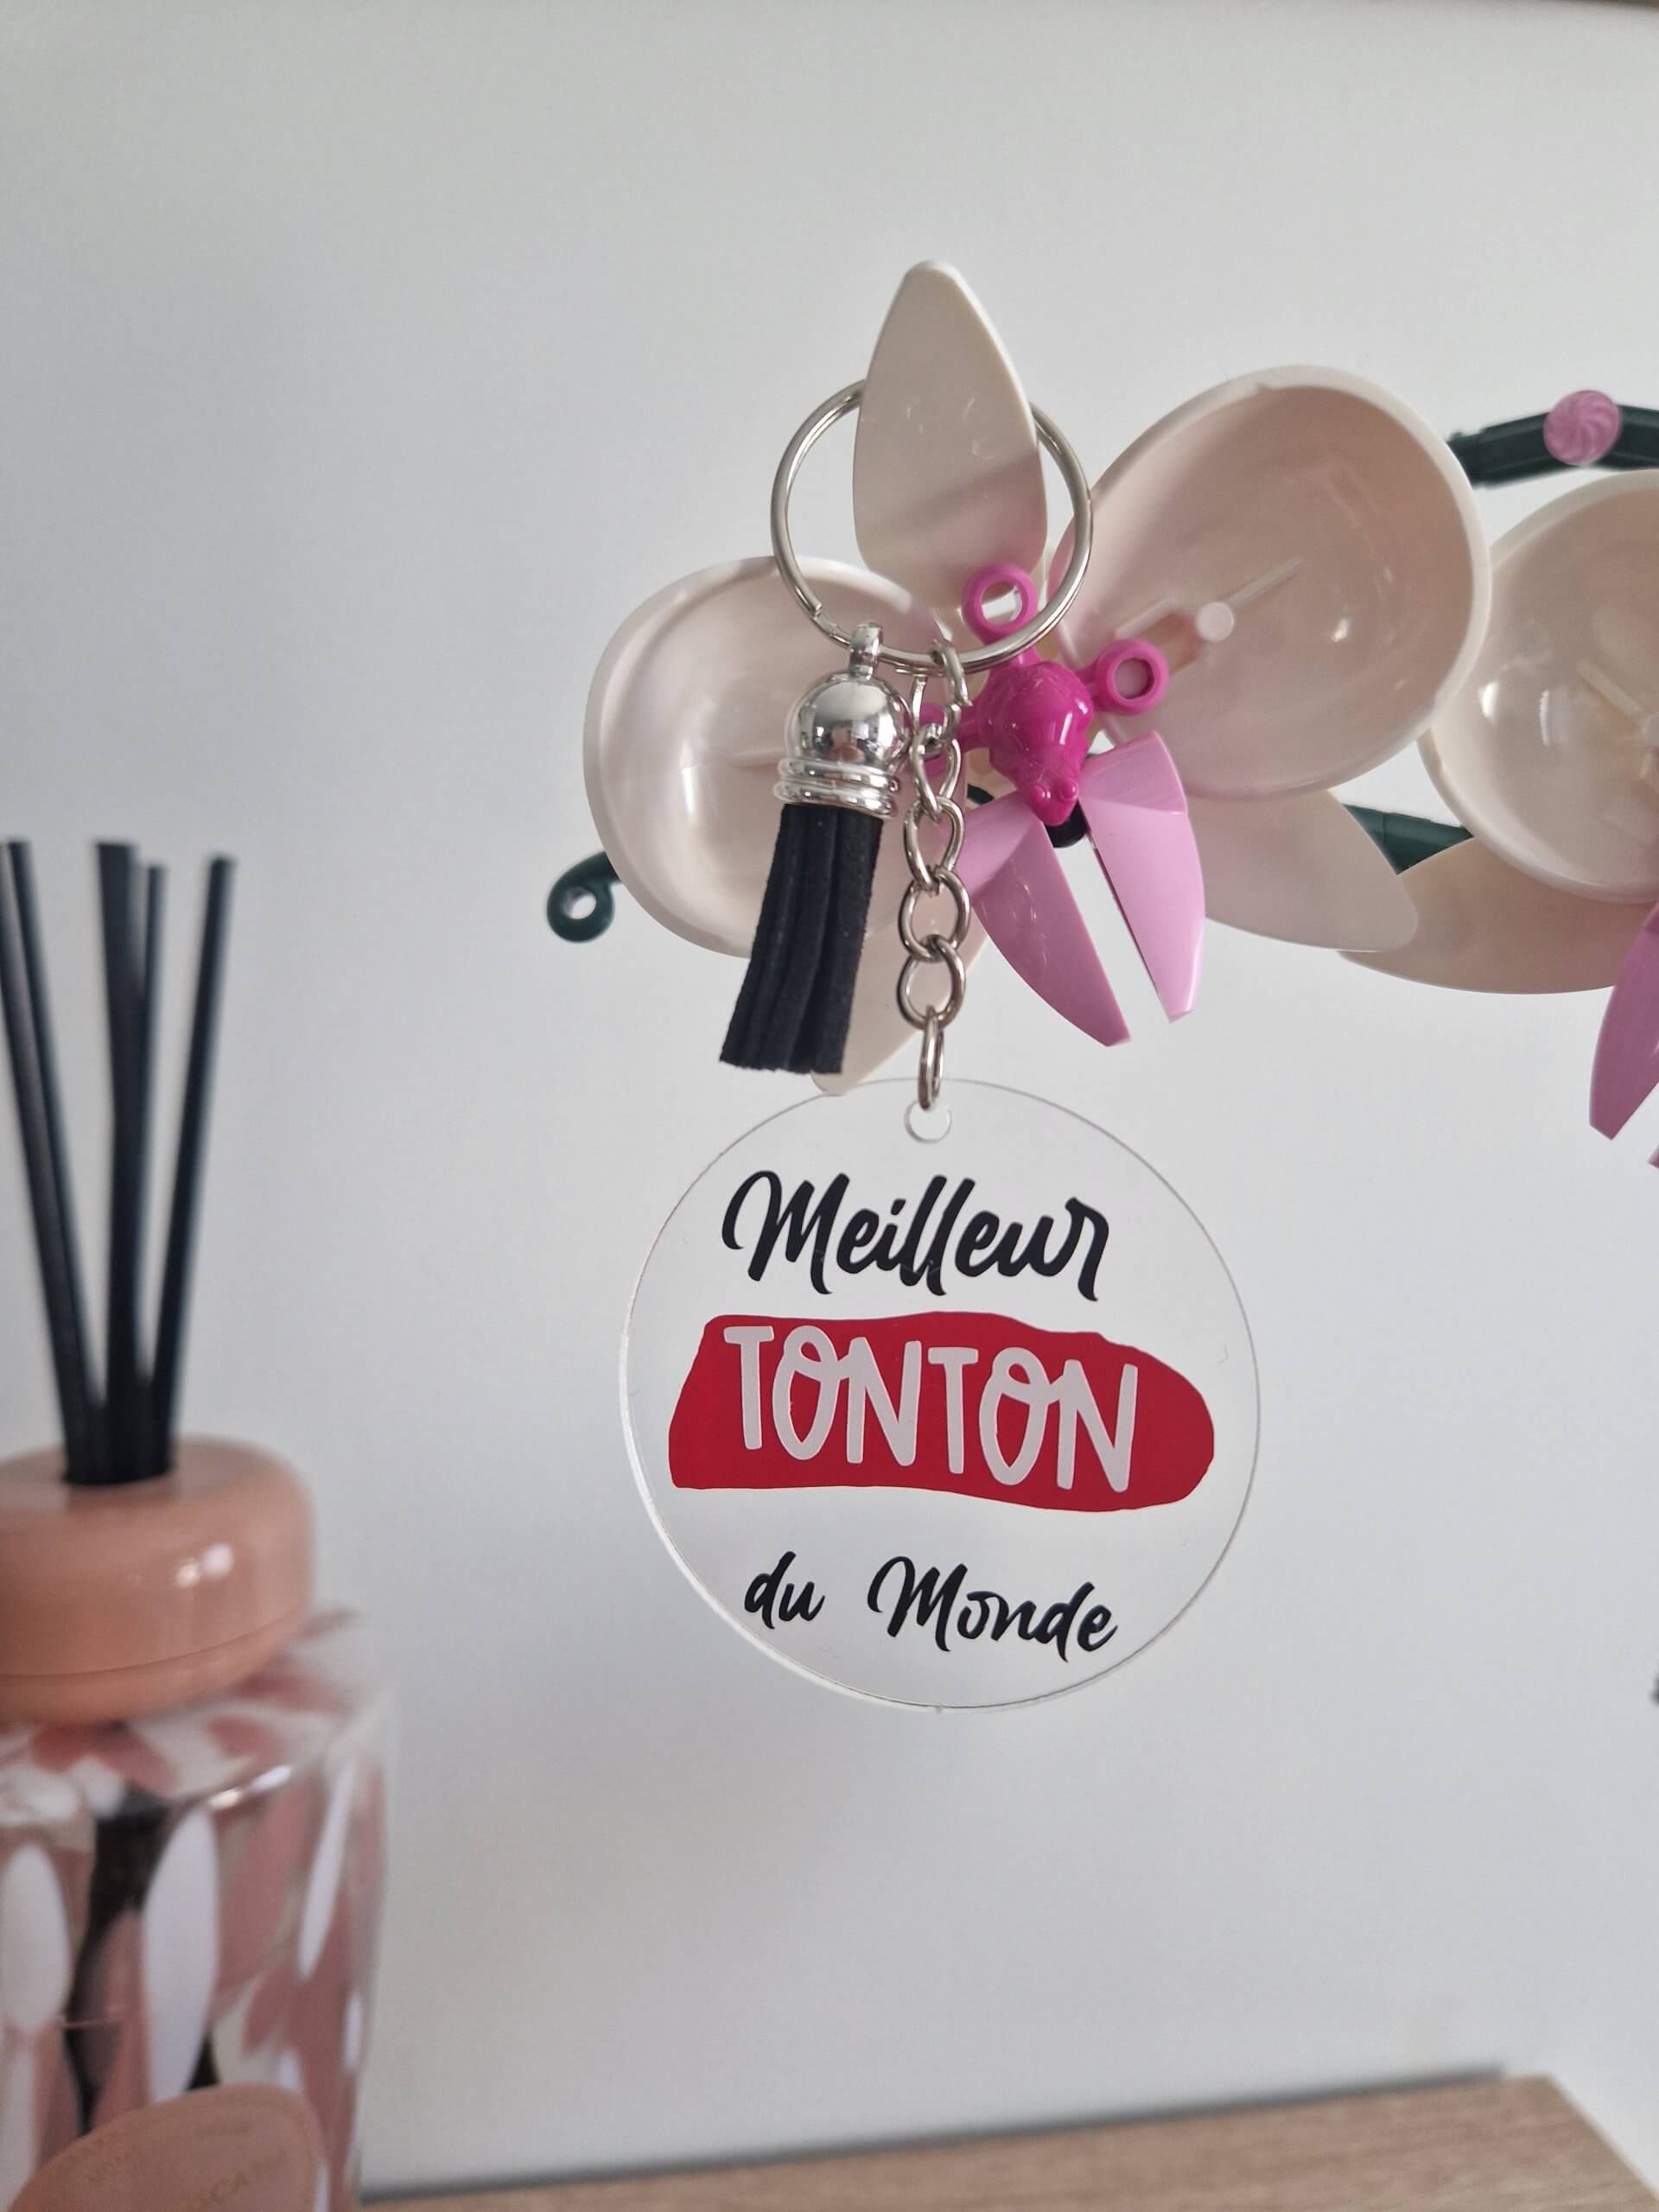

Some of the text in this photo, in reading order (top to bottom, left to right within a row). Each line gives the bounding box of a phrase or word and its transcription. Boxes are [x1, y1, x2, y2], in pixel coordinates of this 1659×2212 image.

[721, 1171, 1109, 1301] Meilleur
[724, 1326, 1138, 1491] TONTON
[744, 1551, 1117, 1662] du Monde
